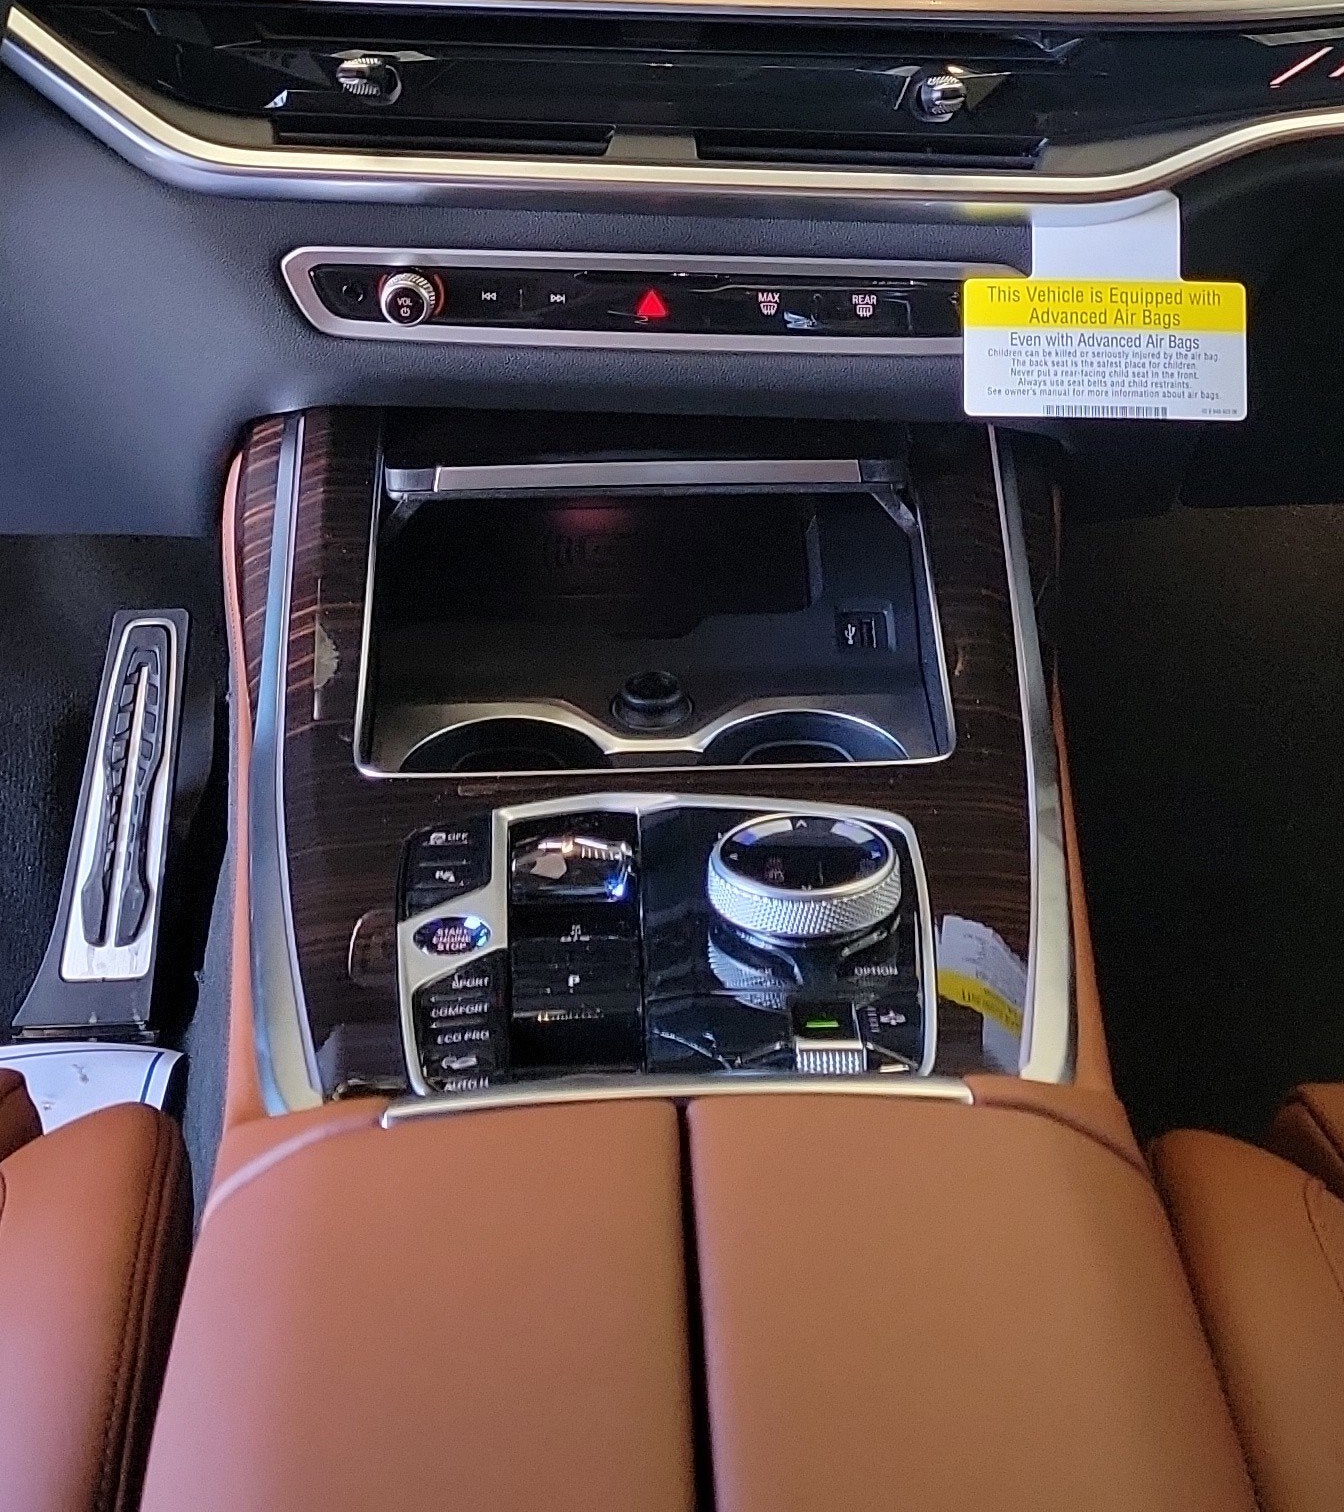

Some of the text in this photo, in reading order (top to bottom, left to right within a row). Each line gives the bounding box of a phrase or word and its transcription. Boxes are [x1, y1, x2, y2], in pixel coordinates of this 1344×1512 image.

[396, 297, 413, 306] VOL
[758, 291, 780, 303] MAX
[852, 294, 877, 305] REAR
[987, 285, 1221, 308] This Vehicle is Equipped with
[1029, 307, 1181, 329] Advanced Air Bags
[1010, 331, 1200, 352] Even with Advanced Air Bags
[987, 348, 1022, 357] Children
[1025, 350, 1040, 358] can
[1042, 349, 1052, 358] be
[1054, 349, 1077, 358] killed
[1091, 350, 1129, 360] seriously
[1132, 351, 1161, 361] injured
[1163, 352, 1173, 362] by
[1176, 351, 1188, 361] the
[1190, 352, 1201, 361] air
[1012, 358, 1026, 367] The
[1029, 358, 1049, 367] back
[1051, 359, 1068, 367] seat
[1070, 359, 1078, 367] is
[1081, 359, 1094, 368] the
[1097, 359, 1122, 368] safest
[1124, 361, 1146, 371] place
[1148, 361, 1161, 369] for
[1010, 368, 1034, 377] Never
[1037, 369, 1051, 378] put
[1108, 370, 1129, 378] child
[1131, 371, 1149, 379] seat
[1151, 370, 1160, 379] in
[1162, 370, 1175, 379] the
[1018, 378, 1047, 388] Always
[1050, 379, 1065, 387] use
[1067, 379, 1085, 387] seat
[1087, 378, 1107, 387] belts
[1110, 379, 1125, 388] and
[1128, 380, 1148, 388] child
[987, 387, 1002, 396] See
[1004, 387, 1037, 396] owner's
[1039, 388, 1070, 397] manual
[1072, 388, 1085, 397] for
[1087, 389, 1109, 397] more
[1111, 389, 1160, 398] information
[1162, 390, 1185, 399] about
[1187, 391, 1198, 399] air
[855, 965, 899, 976] OPTION
[451, 976, 490, 989] SPORT
[431, 1002, 490, 1018] COMFORT
